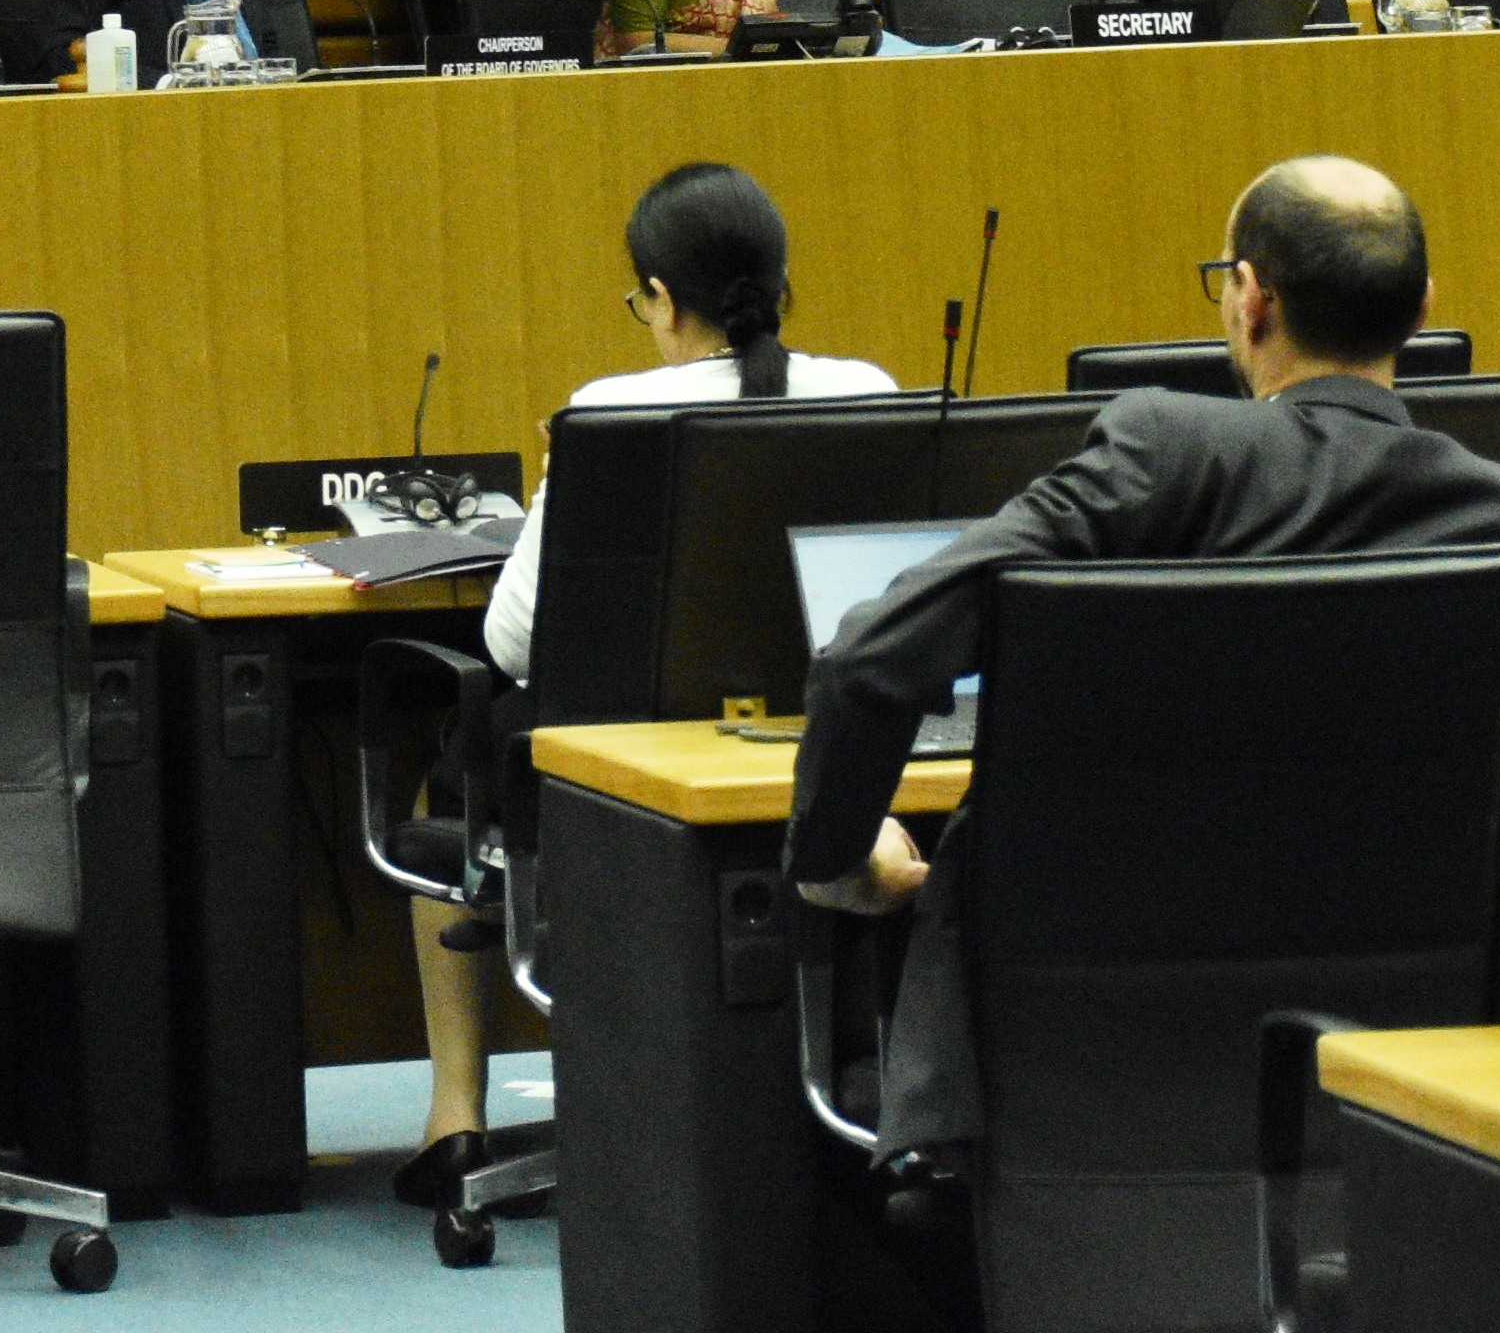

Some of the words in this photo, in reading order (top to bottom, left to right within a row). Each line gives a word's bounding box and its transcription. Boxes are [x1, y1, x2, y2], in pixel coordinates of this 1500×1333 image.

[1097, 11, 1194, 38] SECRETARY
[478, 36, 544, 53] CHAIRPERSON
[441, 63, 455, 76] OF
[456, 63, 475, 76] THE
[475, 61, 508, 75] BOARD
[509, 60, 523, 73] OF
[523, 58, 580, 73] GOVERNORS
